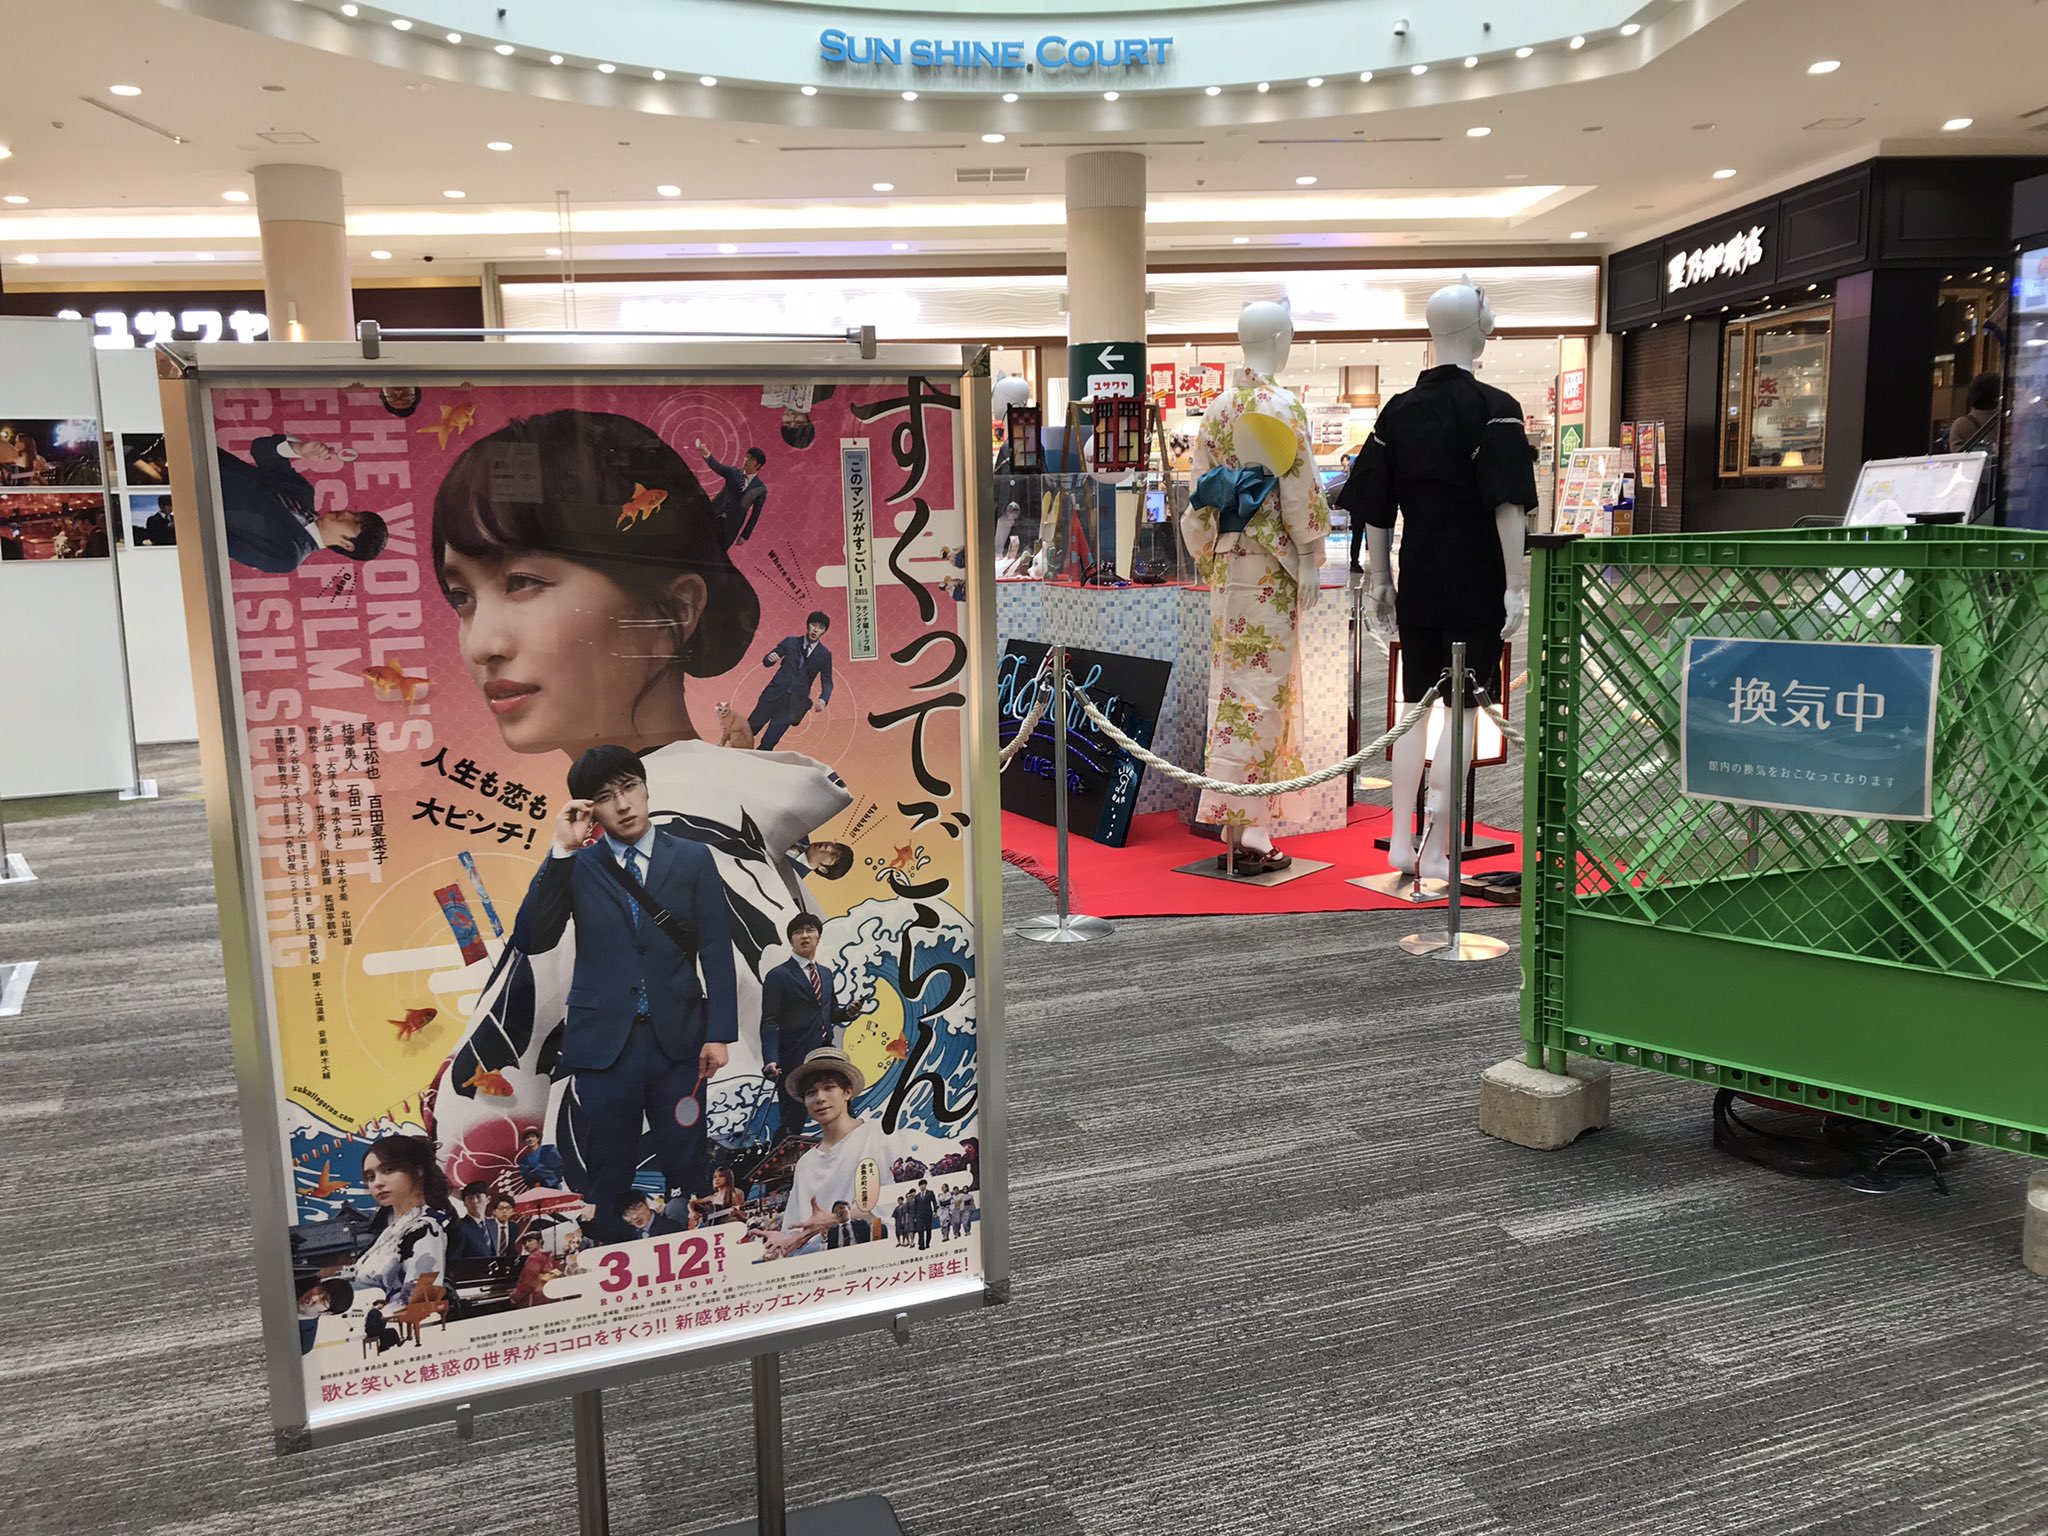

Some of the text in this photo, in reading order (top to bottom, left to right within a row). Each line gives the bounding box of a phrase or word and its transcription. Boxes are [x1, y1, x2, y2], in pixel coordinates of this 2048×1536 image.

[820, 29, 902, 65] SUN
[1035, 36, 1173, 68] COURT
[280, 388, 349, 513] FIRS
[766, 549, 788, 577] Where
[296, 562, 365, 691] FILM
[1728, 677, 1885, 732] 換気中
[341, 723, 364, 836] 柿澤勇人 石田ニコル
[421, 747, 548, 820] 人生も恋も
[851, 376, 978, 1136] すくってごらん
[1118, 766, 1135, 778] LIVE
[1709, 760, 1896, 789] 館内の換気をおこなっております
[361, 722, 388, 864] 尾上松也 百田夏菜子
[1111, 793, 1126, 804] BAR
[243, 686, 326, 969] SCOOPING
[330, 807, 343, 850] 清水みさと
[412, 797, 537, 850] 大ピンチ!
[599, 1233, 726, 1292] 3.12 FRI
[322, 1256, 969, 1402] 歌と笑いと魅惑の世界がココロをすくう!! 新感覚ポップエンターテインメント誕生!
